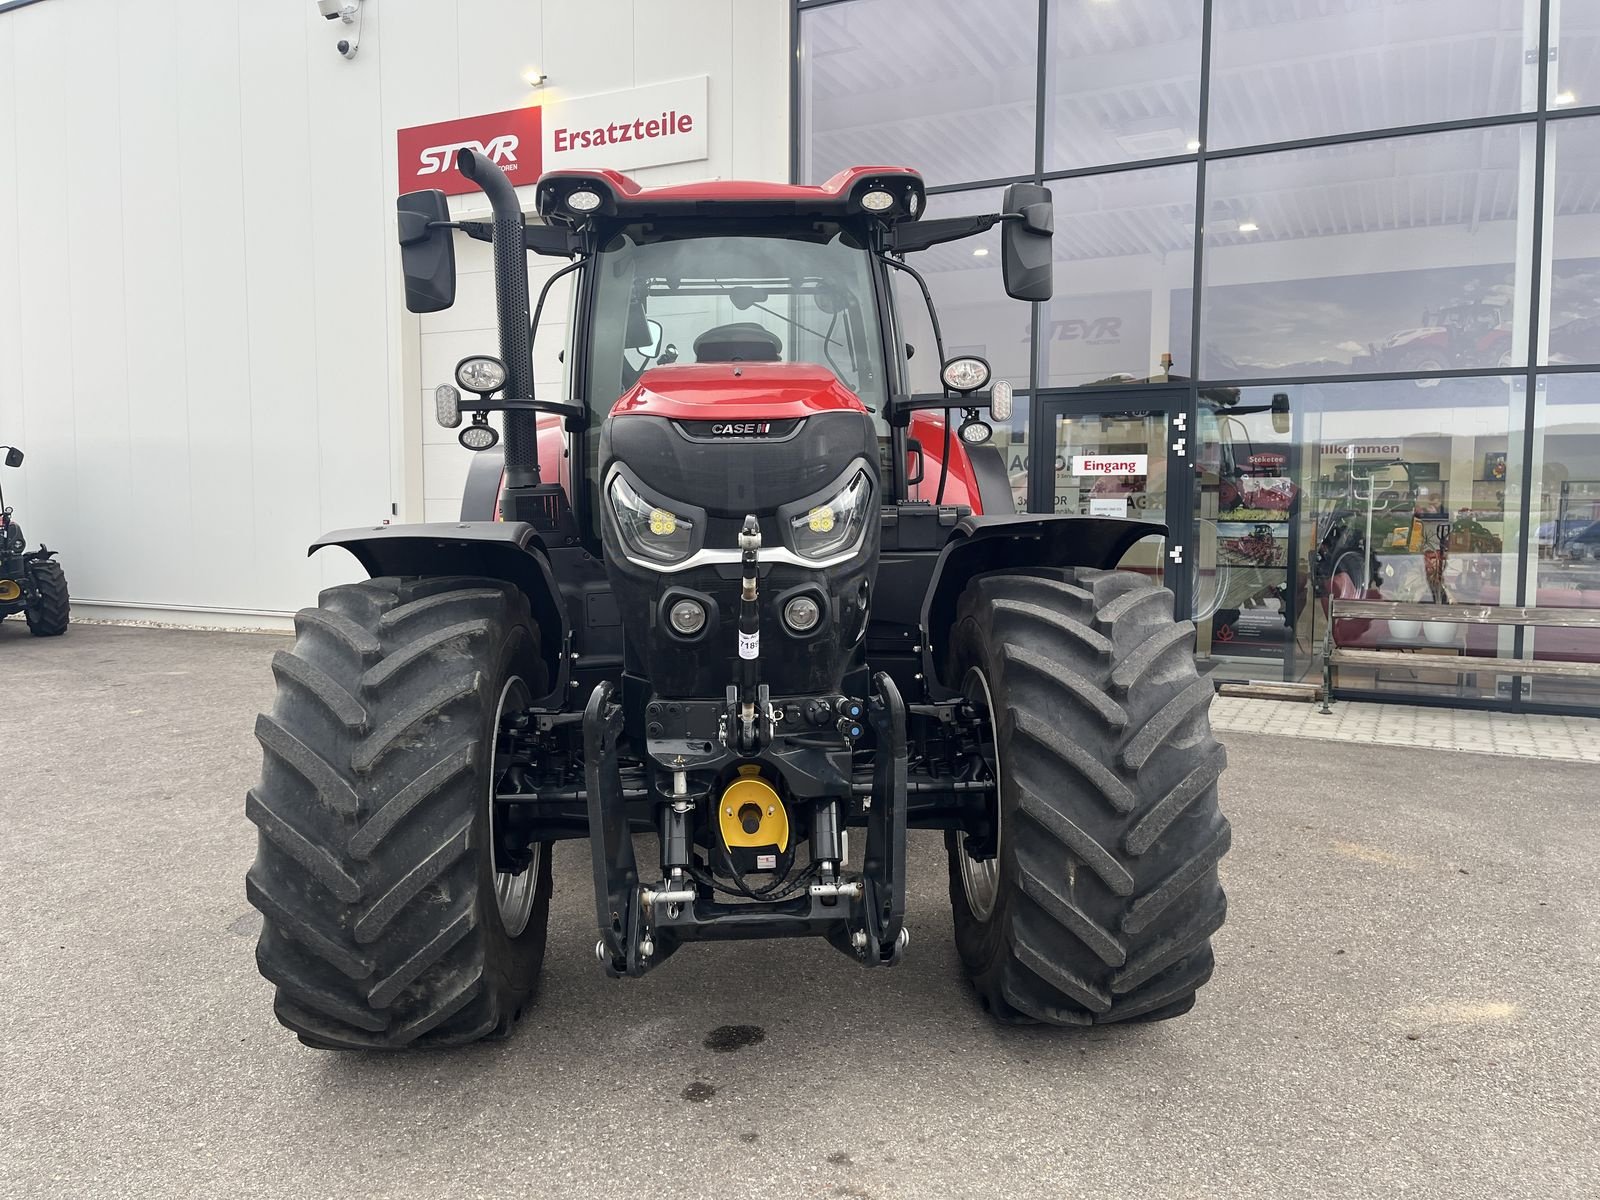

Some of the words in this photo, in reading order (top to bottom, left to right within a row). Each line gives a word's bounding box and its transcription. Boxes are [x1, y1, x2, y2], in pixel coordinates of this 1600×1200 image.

[554, 110, 693, 153] Ersatzteile
[712, 424, 755, 434] CASE
[1320, 444, 1399, 455] illkommen
[1083, 460, 1136, 474] Eingang
